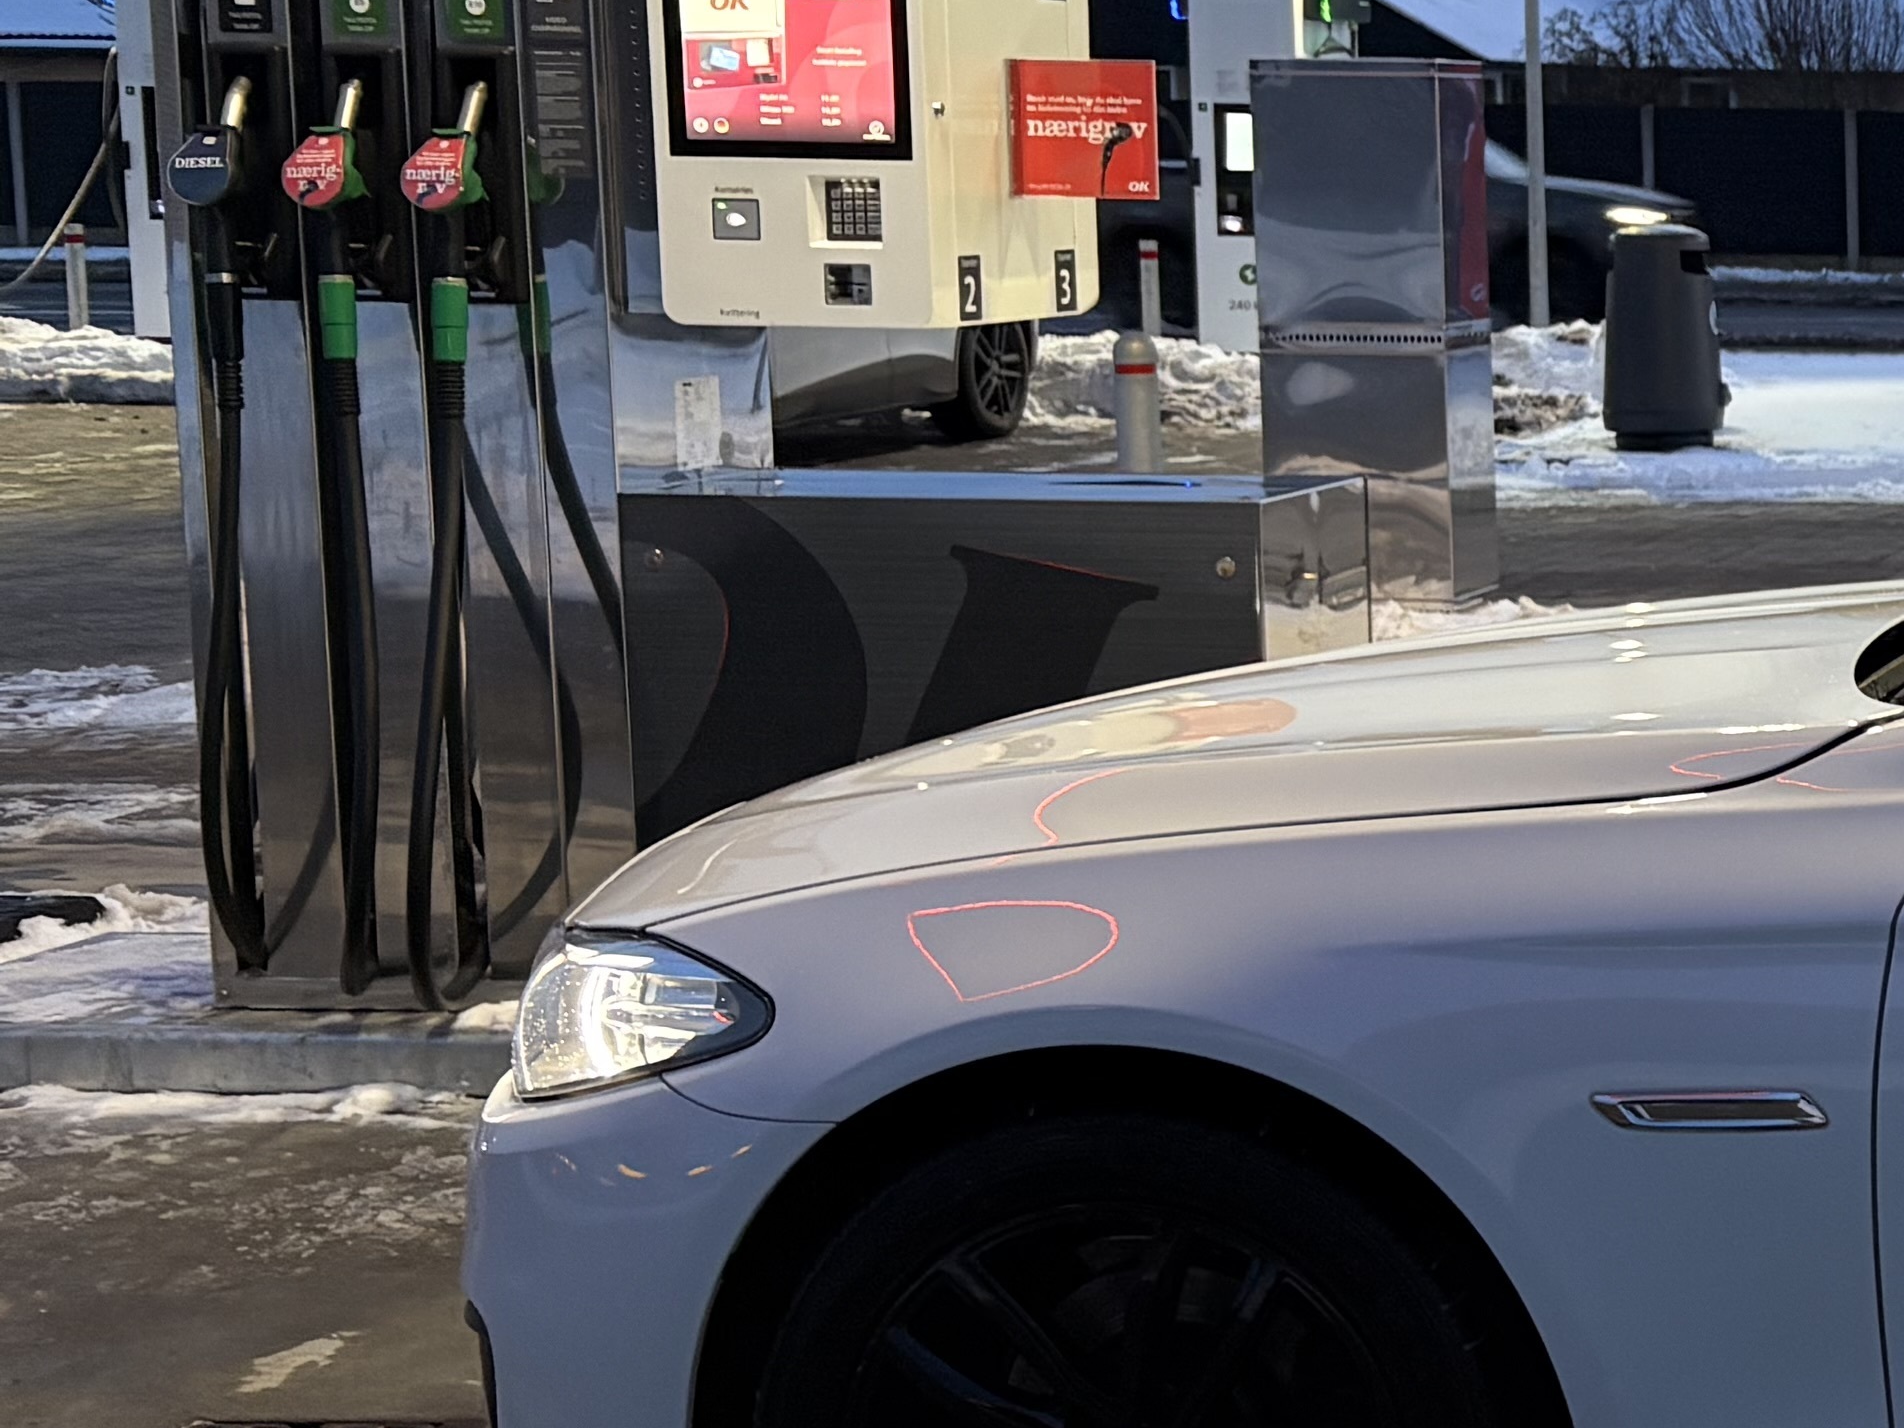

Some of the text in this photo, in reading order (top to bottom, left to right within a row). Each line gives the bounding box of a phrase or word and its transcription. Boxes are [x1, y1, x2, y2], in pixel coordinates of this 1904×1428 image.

[175, 157, 224, 169] DIESEL
[1128, 180, 1150, 192] OK
[1059, 269, 1071, 305] 3
[964, 275, 977, 313] 2
[1229, 299, 1251, 311] 240
